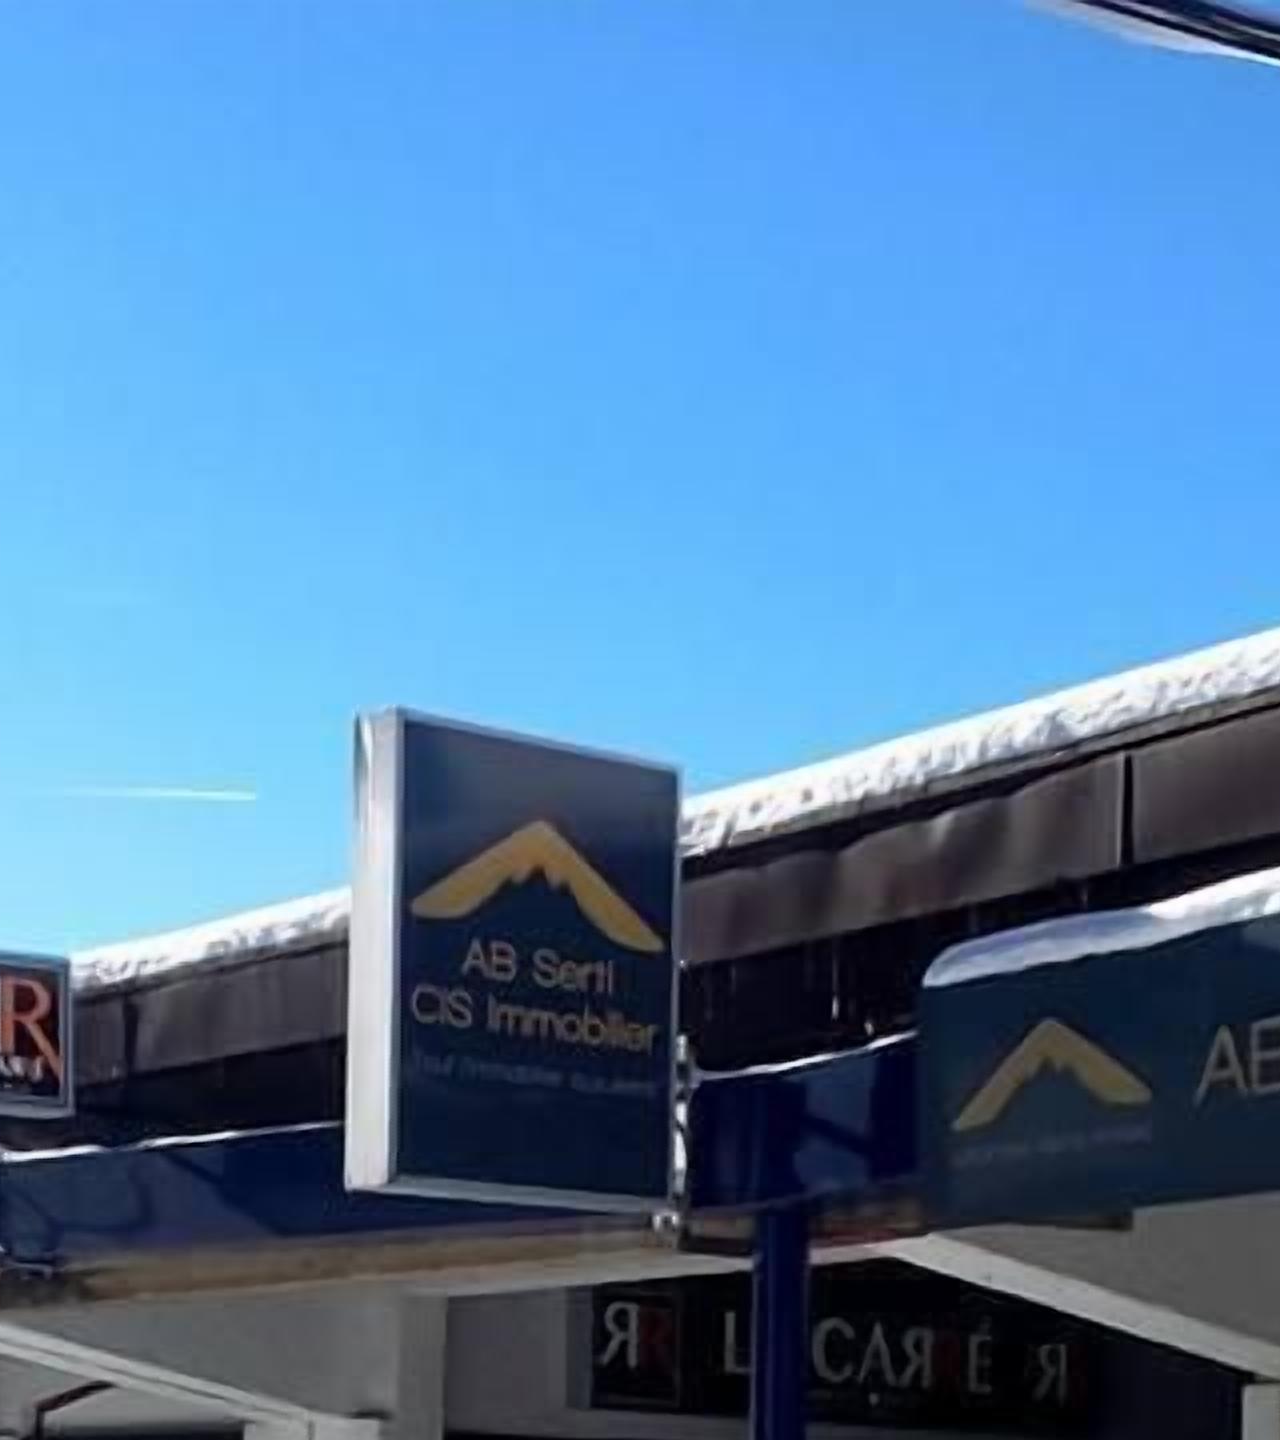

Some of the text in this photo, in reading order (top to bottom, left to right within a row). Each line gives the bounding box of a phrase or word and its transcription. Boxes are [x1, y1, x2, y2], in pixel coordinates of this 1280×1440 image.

[462, 937, 613, 995] AB Serti
[411, 983, 659, 1056] CIS Immobilier
